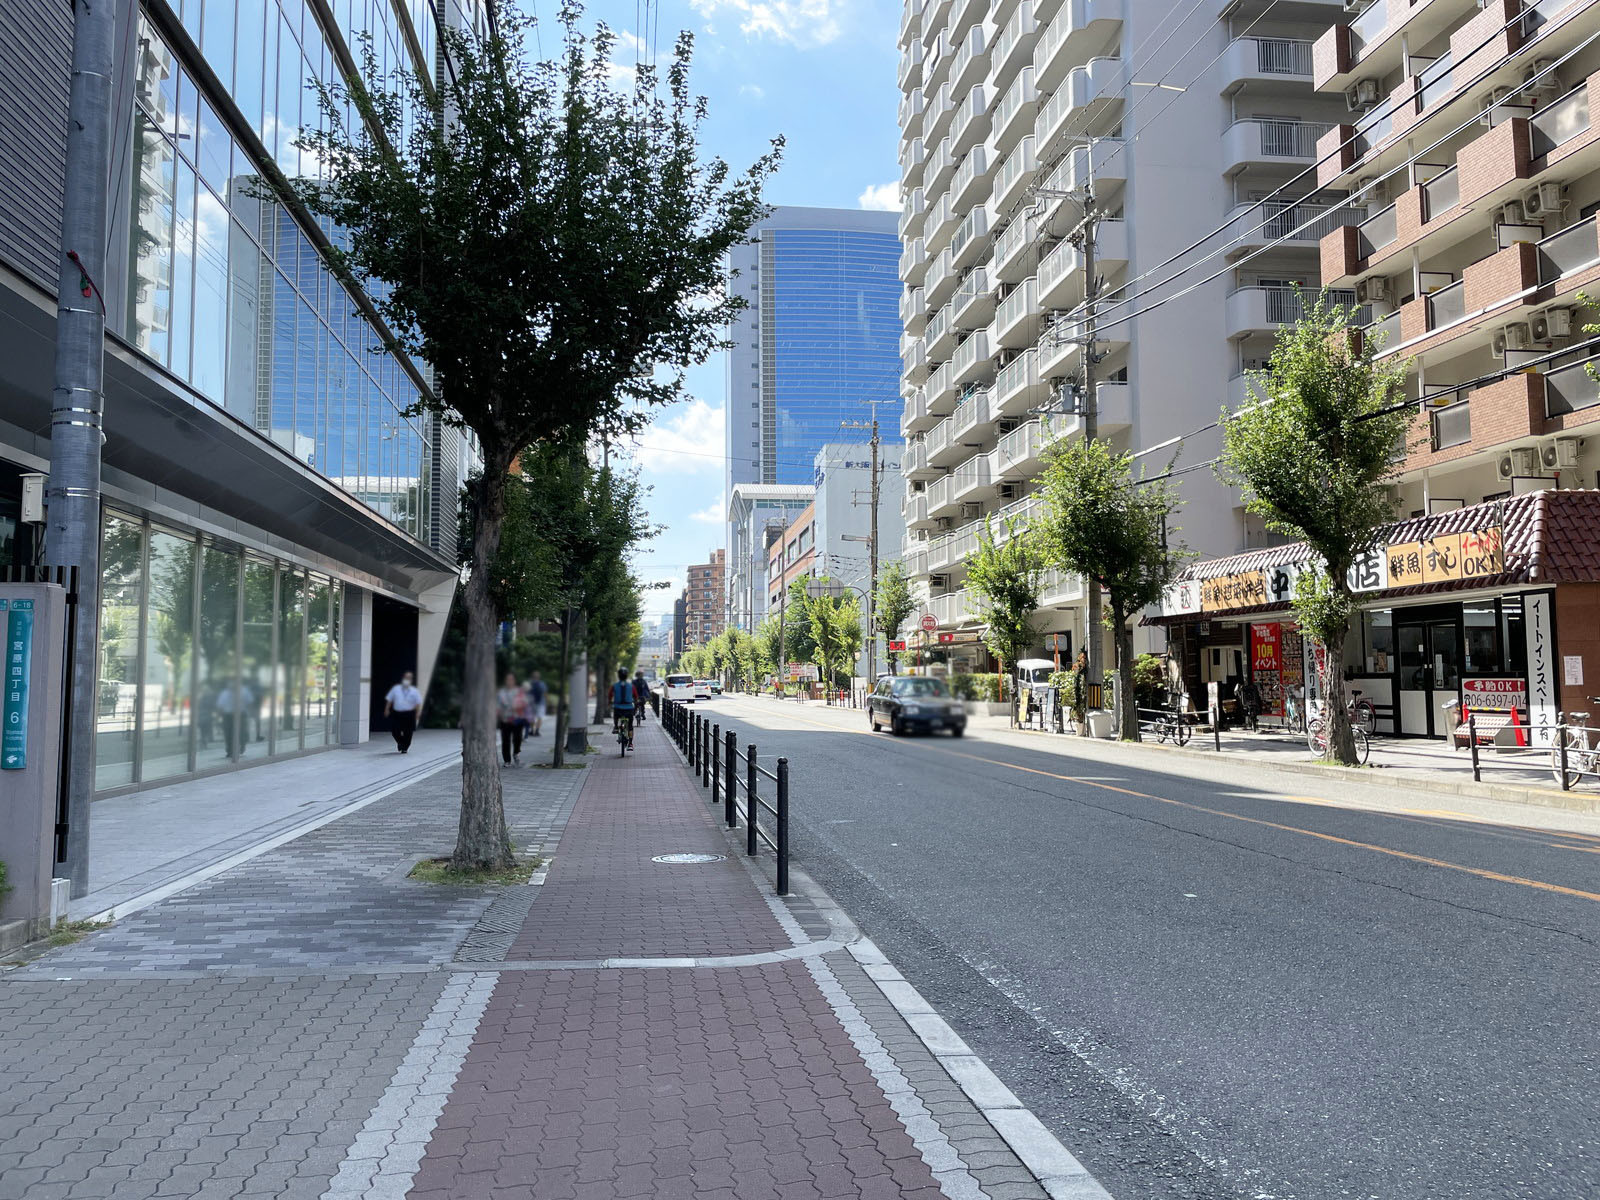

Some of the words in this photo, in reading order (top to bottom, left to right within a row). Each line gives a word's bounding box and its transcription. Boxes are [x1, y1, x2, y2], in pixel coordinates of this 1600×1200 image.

[1464, 554, 1496, 576] OK!
[1256, 643, 1274, 658] 10月
[11, 641, 24, 702] 宮原四丁目
[1255, 658, 1277, 669] イベント
[1533, 599, 1549, 741] イートインスペース有
[10, 711, 20, 724] 6
